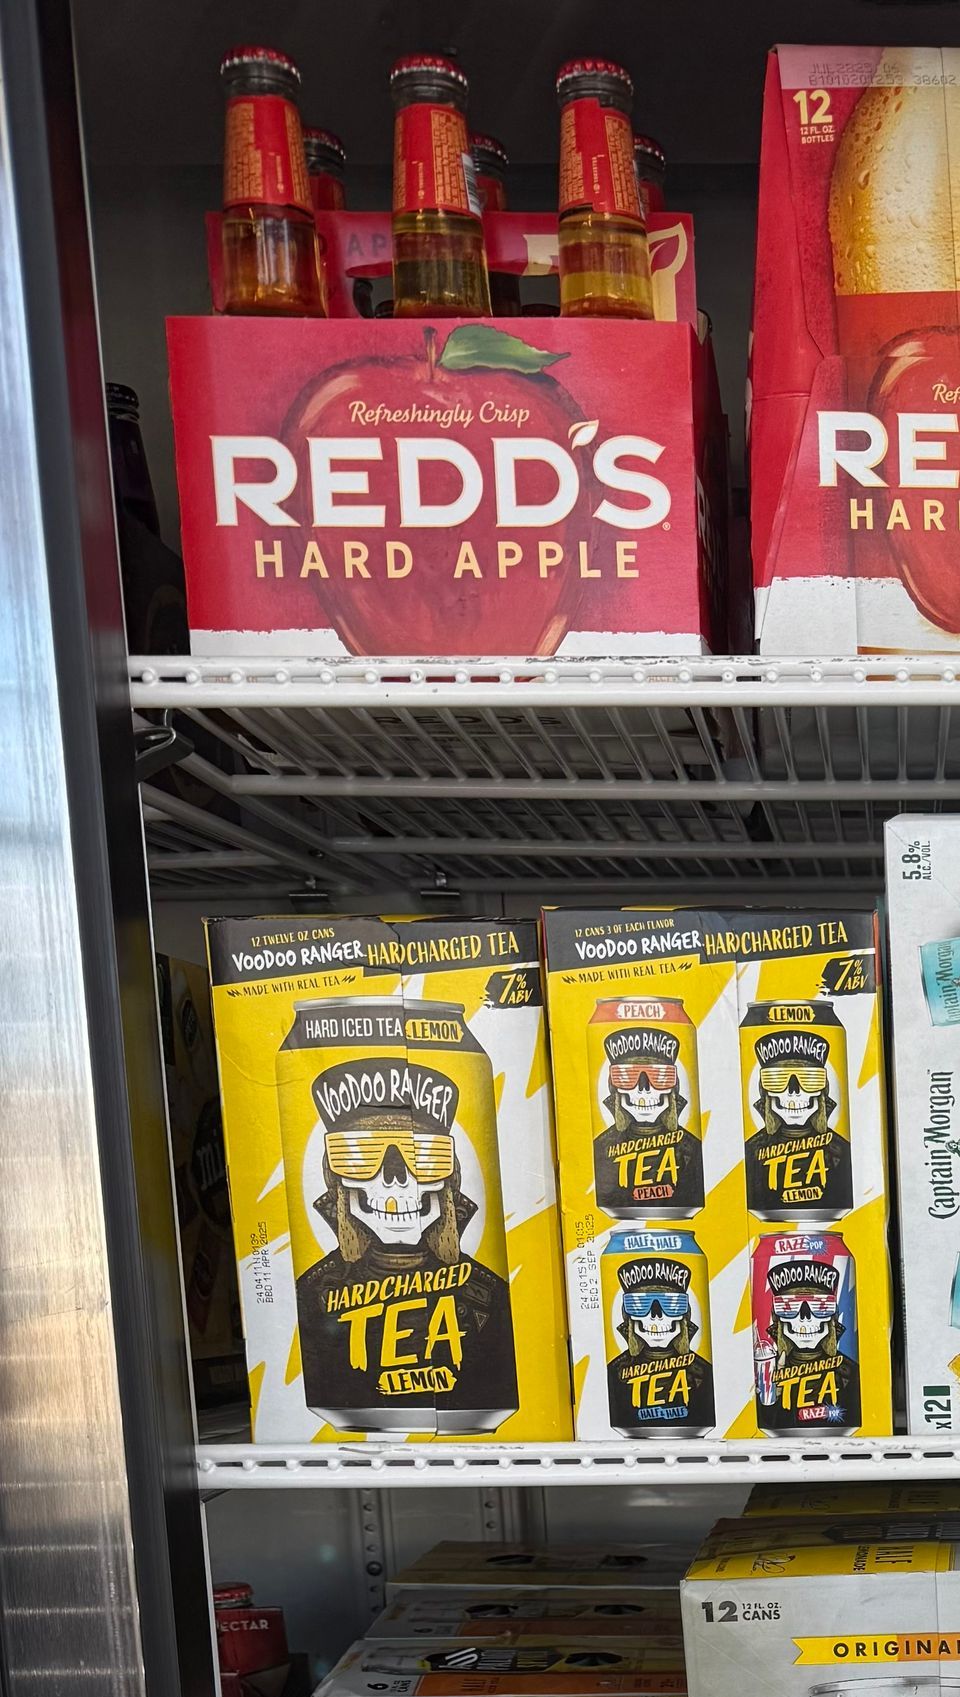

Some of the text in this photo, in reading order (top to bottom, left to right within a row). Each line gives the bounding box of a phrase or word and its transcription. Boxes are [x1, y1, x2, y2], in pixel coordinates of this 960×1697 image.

[793, 90, 832, 124] 12
[800, 127, 808, 135] 12
[802, 135, 834, 144] BOTTLES
[349, 401, 529, 428] Refreshingly Crisp
[209, 419, 672, 531] REDD'S
[255, 541, 639, 579] HARD APPLE
[902, 840, 922, 881] 5.8%
[922, 840, 932, 880] ALC./VOL.
[252, 928, 334, 947] 12 TWELVE OZ CANS
[575, 921, 847, 960] VOODOO RANGER HARDCHARGED TEA
[232, 932, 519, 972] VOODOO RANGER HARDCHARGED TEA
[500, 973, 527, 1003] 7%
[508, 989, 533, 1005] ABV
[624, 1003, 660, 1017] PEACH
[774, 1007, 811, 1021] LEMON
[306, 1017, 459, 1040] HARD ICED TEA LEMON
[924, 1071, 960, 1219] Captain Morgan
[327, 1263, 471, 1312] HARDCHARGED
[337, 1295, 467, 1371] TEA
[388, 1369, 448, 1392] LEMON
[702, 1601, 738, 1623] 12
[743, 1609, 780, 1621] CANS
